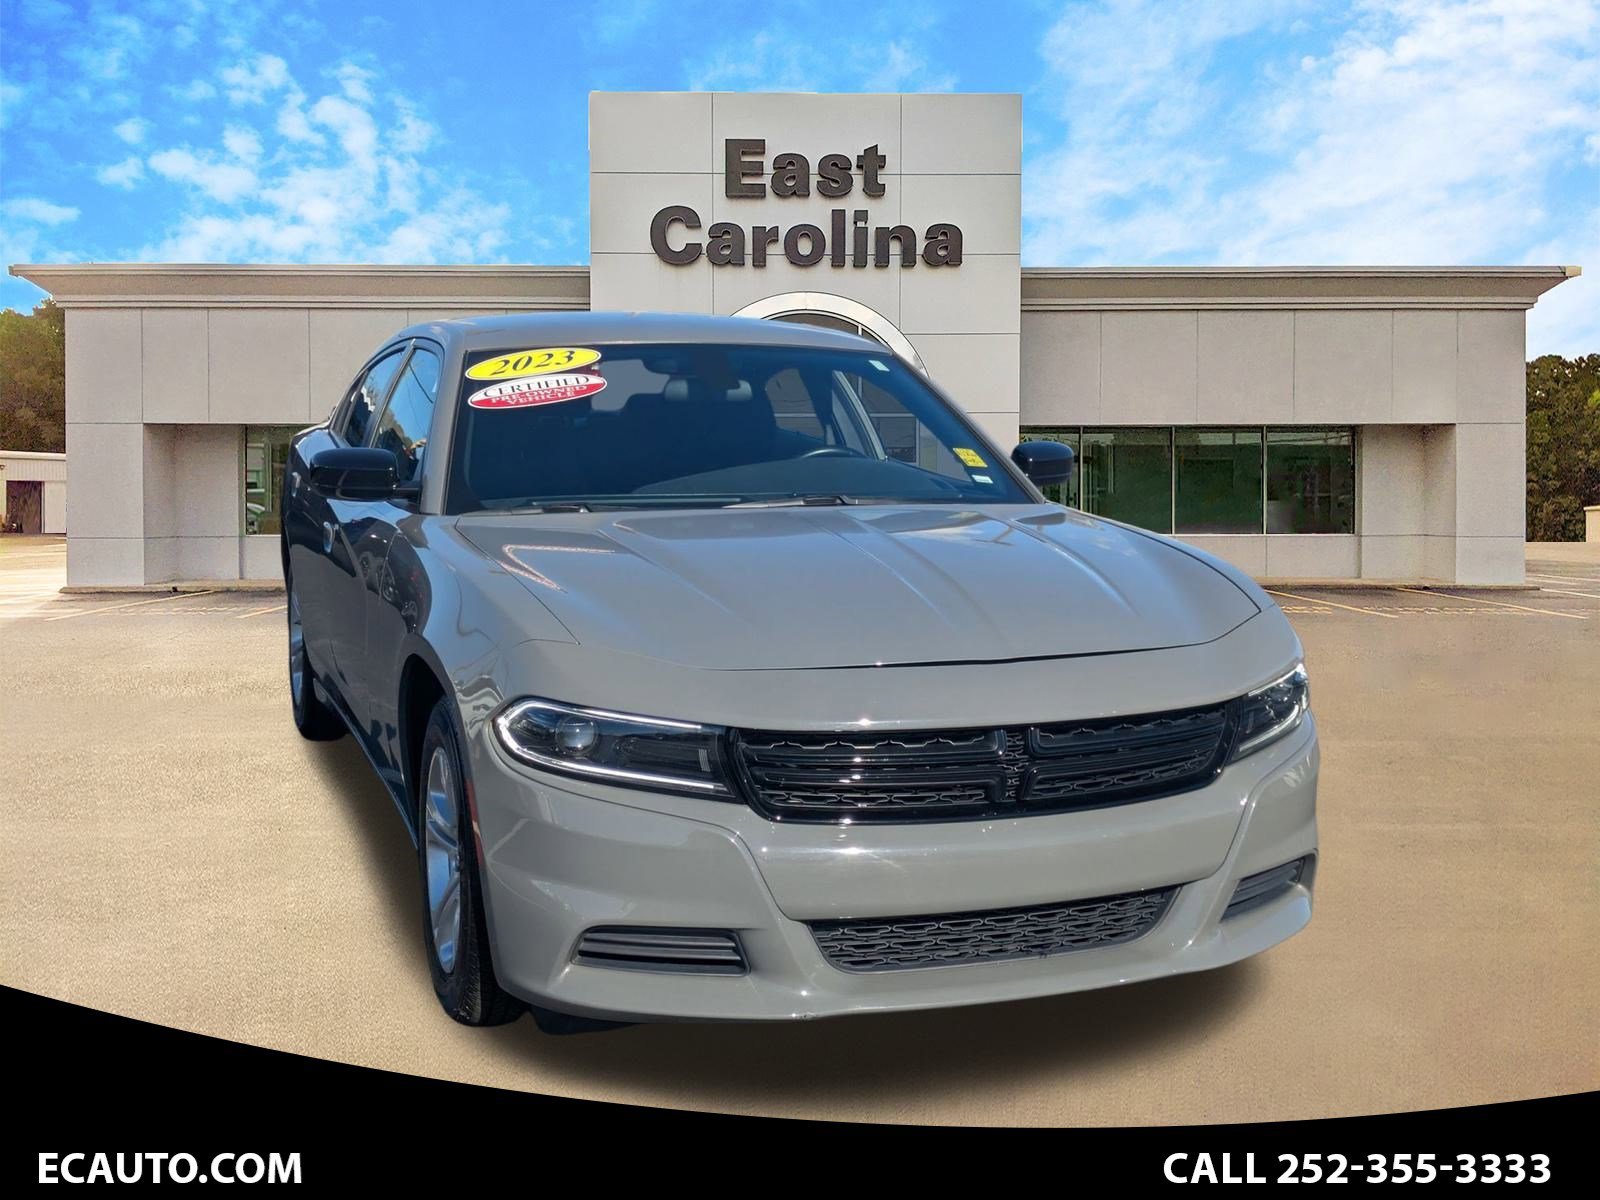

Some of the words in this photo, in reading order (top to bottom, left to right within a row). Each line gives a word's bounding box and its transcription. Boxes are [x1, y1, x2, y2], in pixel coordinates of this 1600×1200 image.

[725, 138, 887, 198] East
[650, 205, 963, 267] Carolina
[490, 350, 576, 376] 2023
[484, 375, 590, 398] CERTIFIED
[507, 391, 576, 405] VEHICLE
